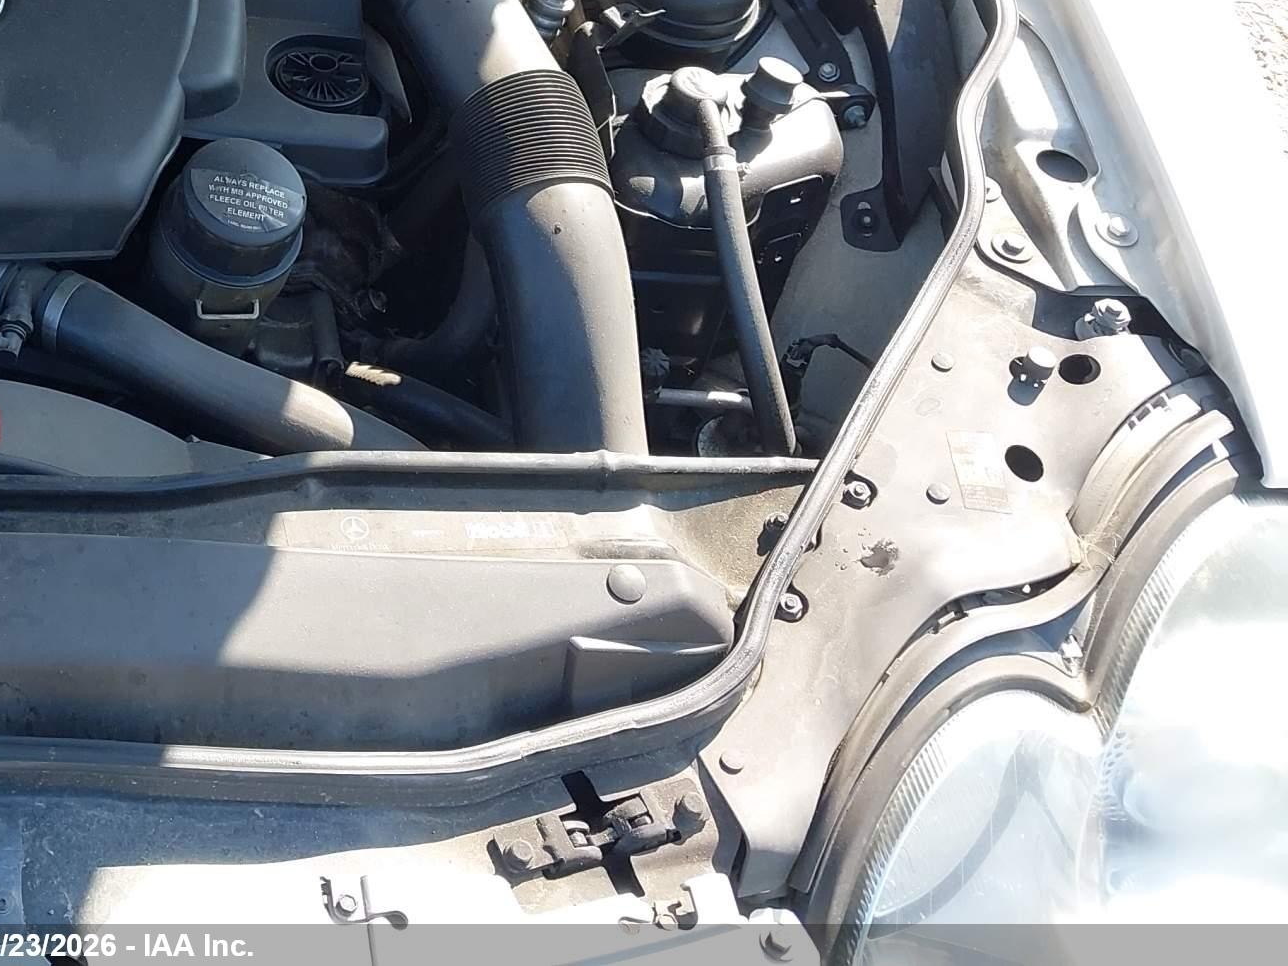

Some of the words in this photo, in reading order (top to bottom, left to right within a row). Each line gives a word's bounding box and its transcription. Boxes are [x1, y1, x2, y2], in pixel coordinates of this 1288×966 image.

[214, 175, 247, 187] ALWAYS
[249, 181, 285, 198] REPLACE
[209, 194, 241, 205] FLEECE
[243, 200, 256, 209] OIL
[246, 191, 288, 209] APPROVED
[227, 207, 264, 221] ELEMENT
